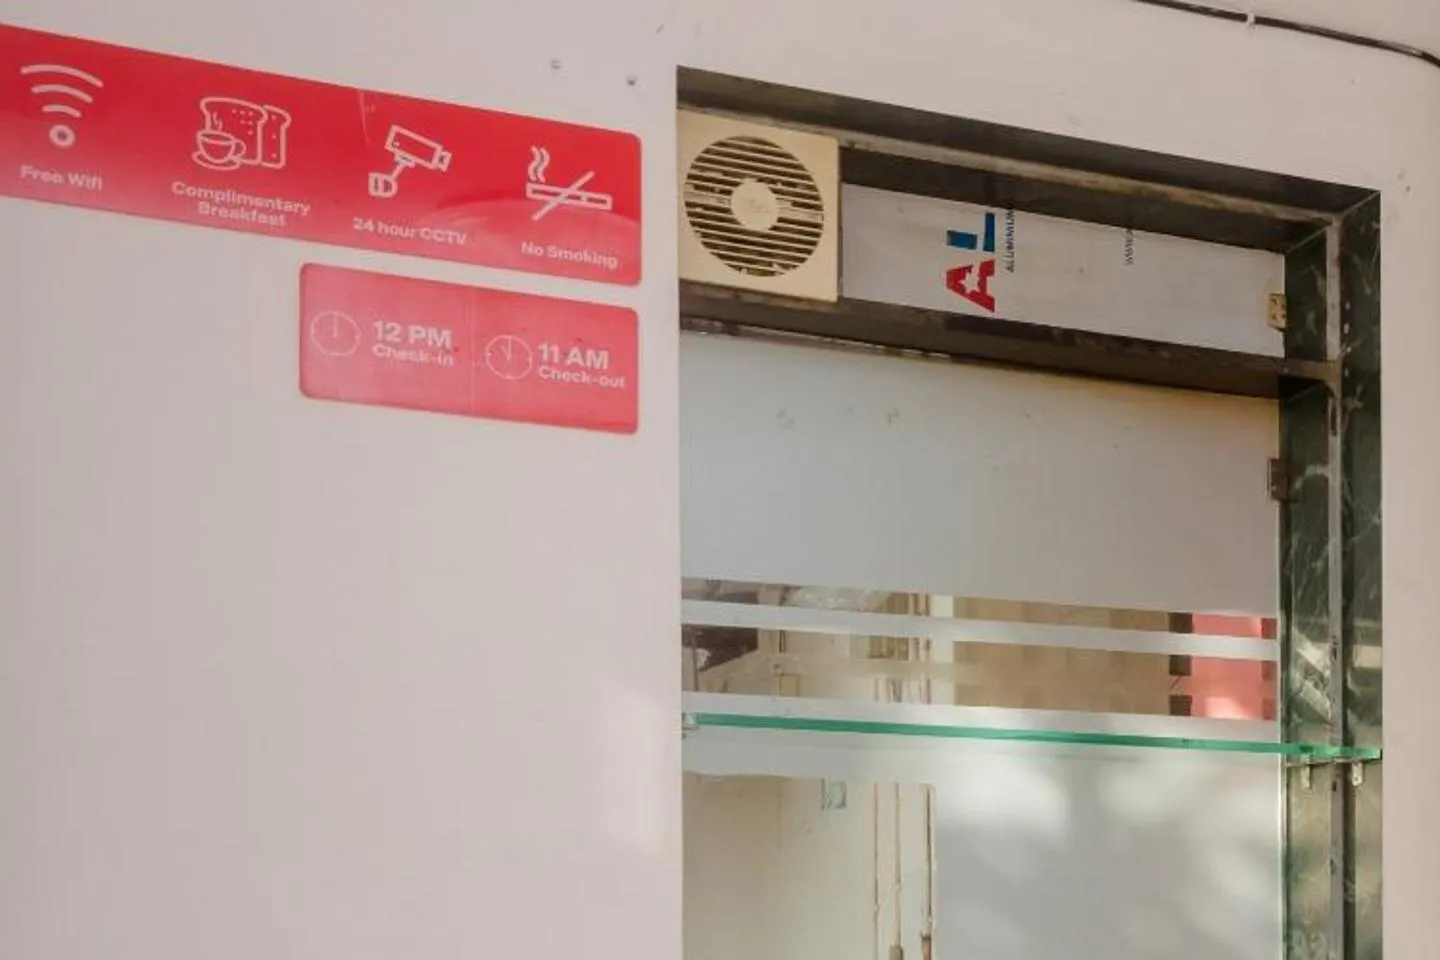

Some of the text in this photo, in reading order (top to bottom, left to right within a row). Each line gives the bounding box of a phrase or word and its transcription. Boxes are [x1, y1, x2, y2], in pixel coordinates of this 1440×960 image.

[20, 164, 103, 191] Free Wifi
[171, 180, 310, 216] Complimentary
[197, 200, 287, 227] Breakfast
[353, 217, 467, 245] 24 hour CCTV
[521, 241, 618, 270] No Smoking
[373, 320, 451, 350] 12 PM
[372, 342, 454, 367] Check-in
[538, 342, 609, 370] 11 AM
[537, 364, 625, 388] Check-out
